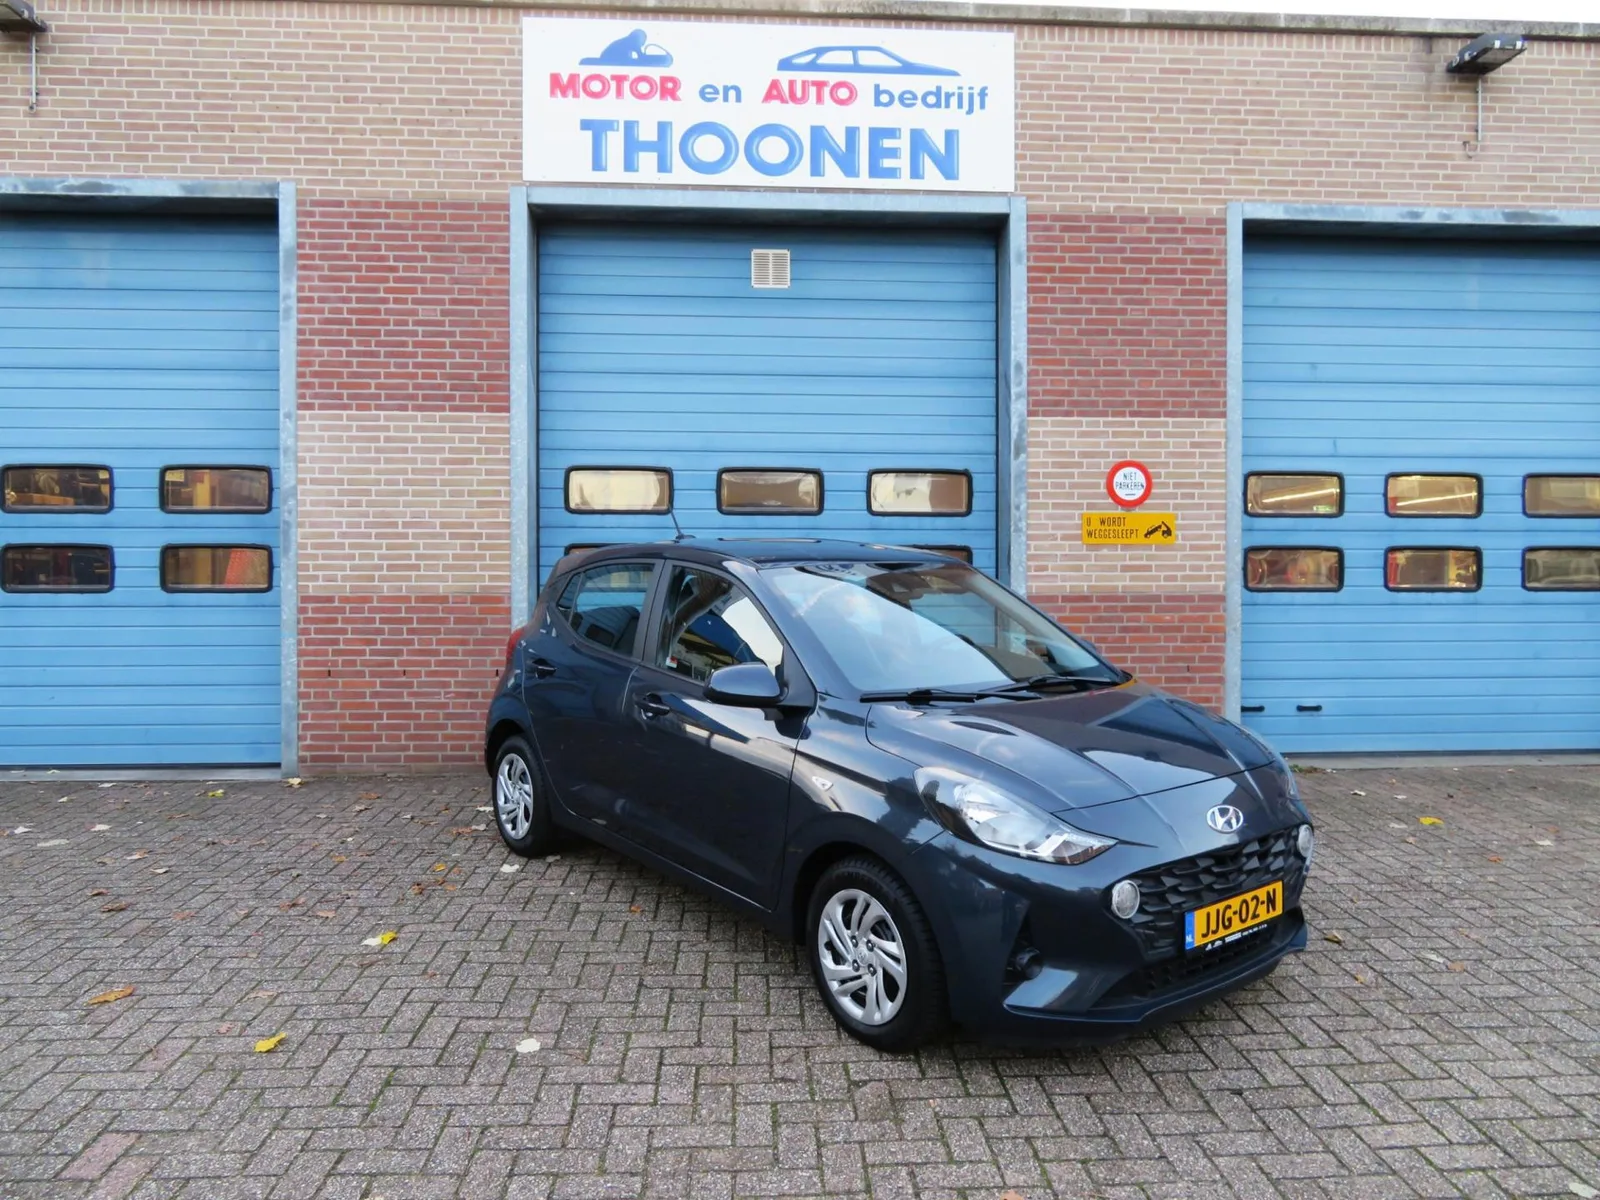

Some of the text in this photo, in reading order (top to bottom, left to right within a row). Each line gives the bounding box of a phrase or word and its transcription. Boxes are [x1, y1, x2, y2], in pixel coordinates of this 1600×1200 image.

[549, 72, 989, 116] MOTOR en AUTO bedrijf
[579, 118, 960, 181] THOONEN
[1123, 472, 1137, 480] NIET
[1115, 481, 1145, 490] PARKEREN
[1086, 517, 1126, 526] U WORDT
[1086, 528, 1139, 539] WEGGESLEEPT
[1201, 888, 1277, 939] JJG-02-N
